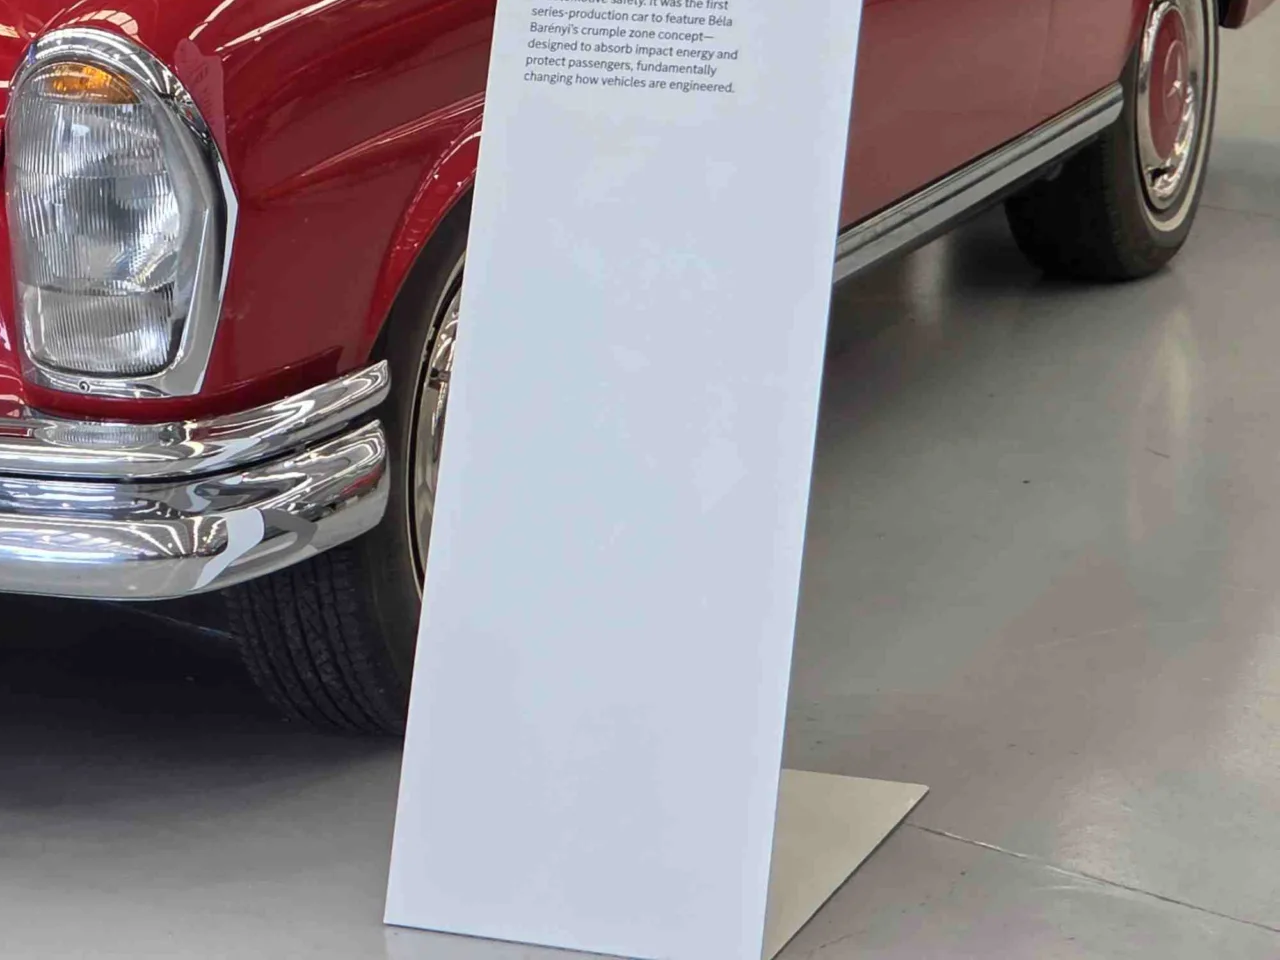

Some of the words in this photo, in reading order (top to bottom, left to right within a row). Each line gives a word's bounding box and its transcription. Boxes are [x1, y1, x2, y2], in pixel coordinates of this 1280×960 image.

[660, 0, 683, 8] was
[530, 6, 629, 21] series-production
[631, 13, 649, 22] car
[651, 13, 664, 23] to
[665, 13, 706, 26] feature
[708, 14, 733, 27] Béla
[580, 26, 627, 38] crumple
[628, 29, 656, 39] zone
[527, 38, 578, 52] designed
[580, 42, 592, 52] to
[593, 42, 633, 55] absorb
[635, 43, 674, 57] impact
[676, 48, 715, 61] energy
[716, 49, 739, 60] and
[525, 55, 566, 67] protect
[568, 58, 634, 72] passengers,
[636, 60, 717, 78] fundamentally
[523, 71, 573, 86] changing
[575, 74, 600, 85] how
[601, 76, 646, 88] vehicles
[648, 80, 667, 89] are
[669, 80, 736, 93] engineered.
